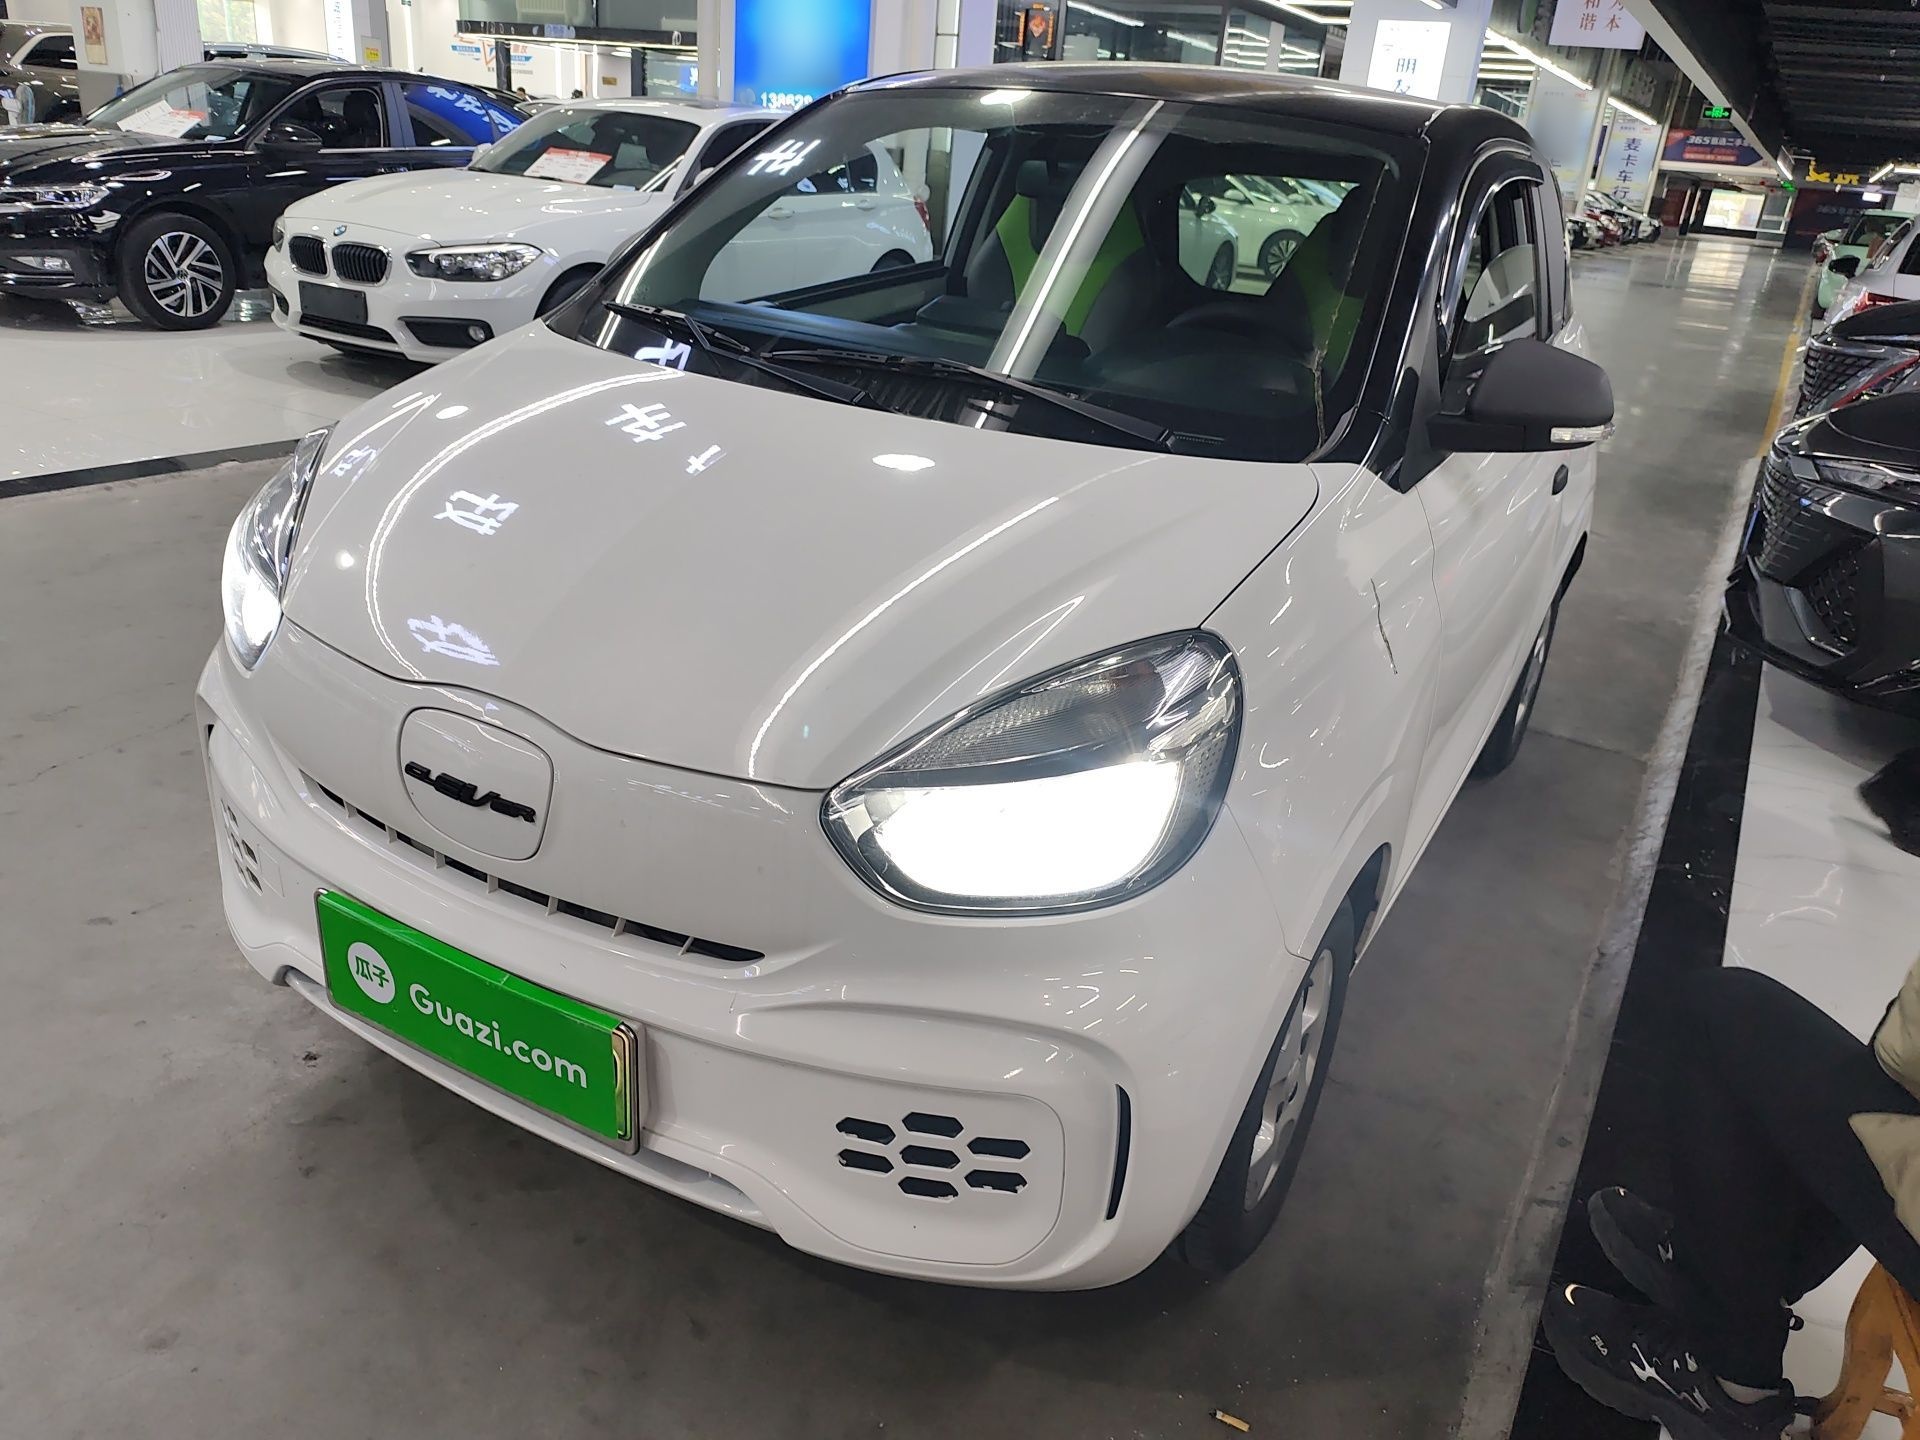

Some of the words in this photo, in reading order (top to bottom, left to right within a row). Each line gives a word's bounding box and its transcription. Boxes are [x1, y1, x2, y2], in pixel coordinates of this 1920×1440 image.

[1611, 137, 1643, 200] 麦卡车行
[354, 954, 390, 989] 瓜子
[409, 982, 589, 1089] Guazi.com
